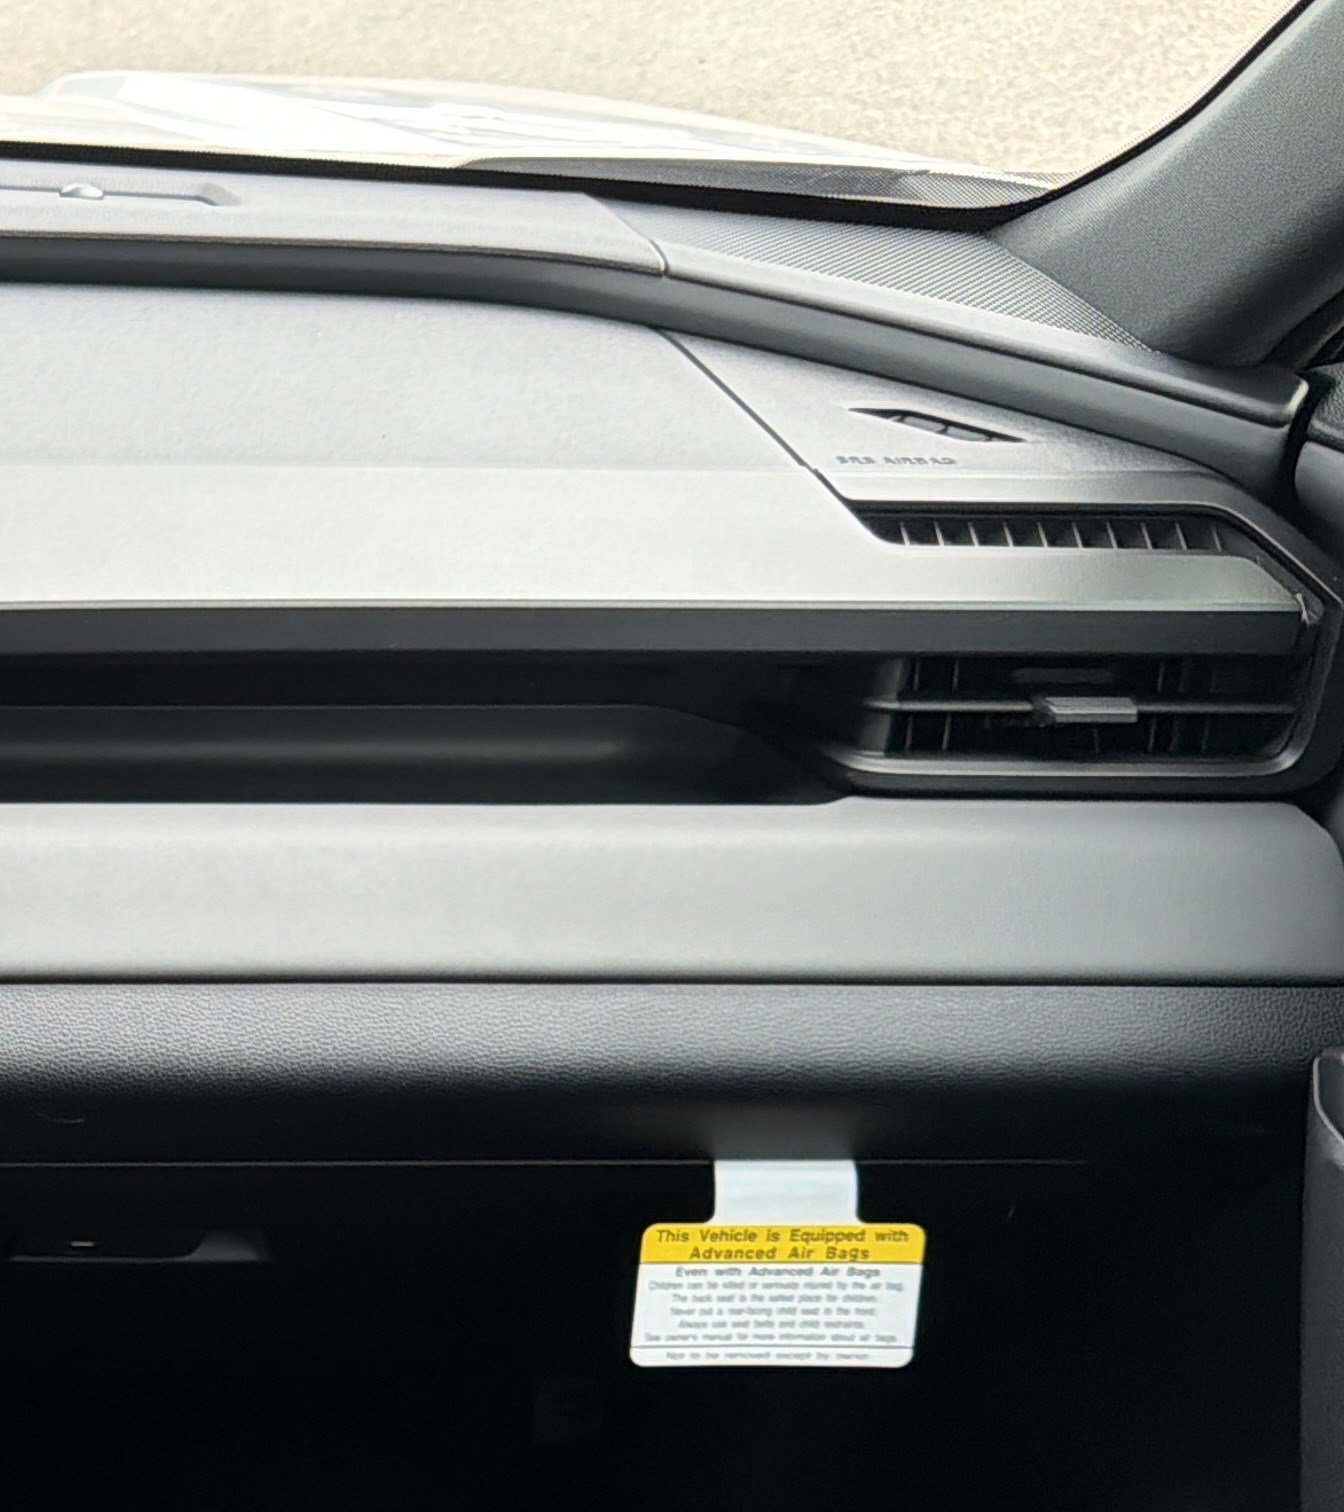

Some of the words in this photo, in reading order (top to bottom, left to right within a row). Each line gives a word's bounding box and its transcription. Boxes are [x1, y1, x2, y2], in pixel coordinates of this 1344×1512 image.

[657, 1229, 690, 1242] This
[700, 1229, 758, 1242] Vehicle
[767, 1229, 780, 1242] is
[790, 1229, 866, 1245] Equipped
[875, 1230, 909, 1242] with
[689, 1246, 777, 1259] Advanced
[788, 1246, 814, 1259] Air
[825, 1246, 870, 1261] Bags
[749, 1267, 813, 1277] Advanced
